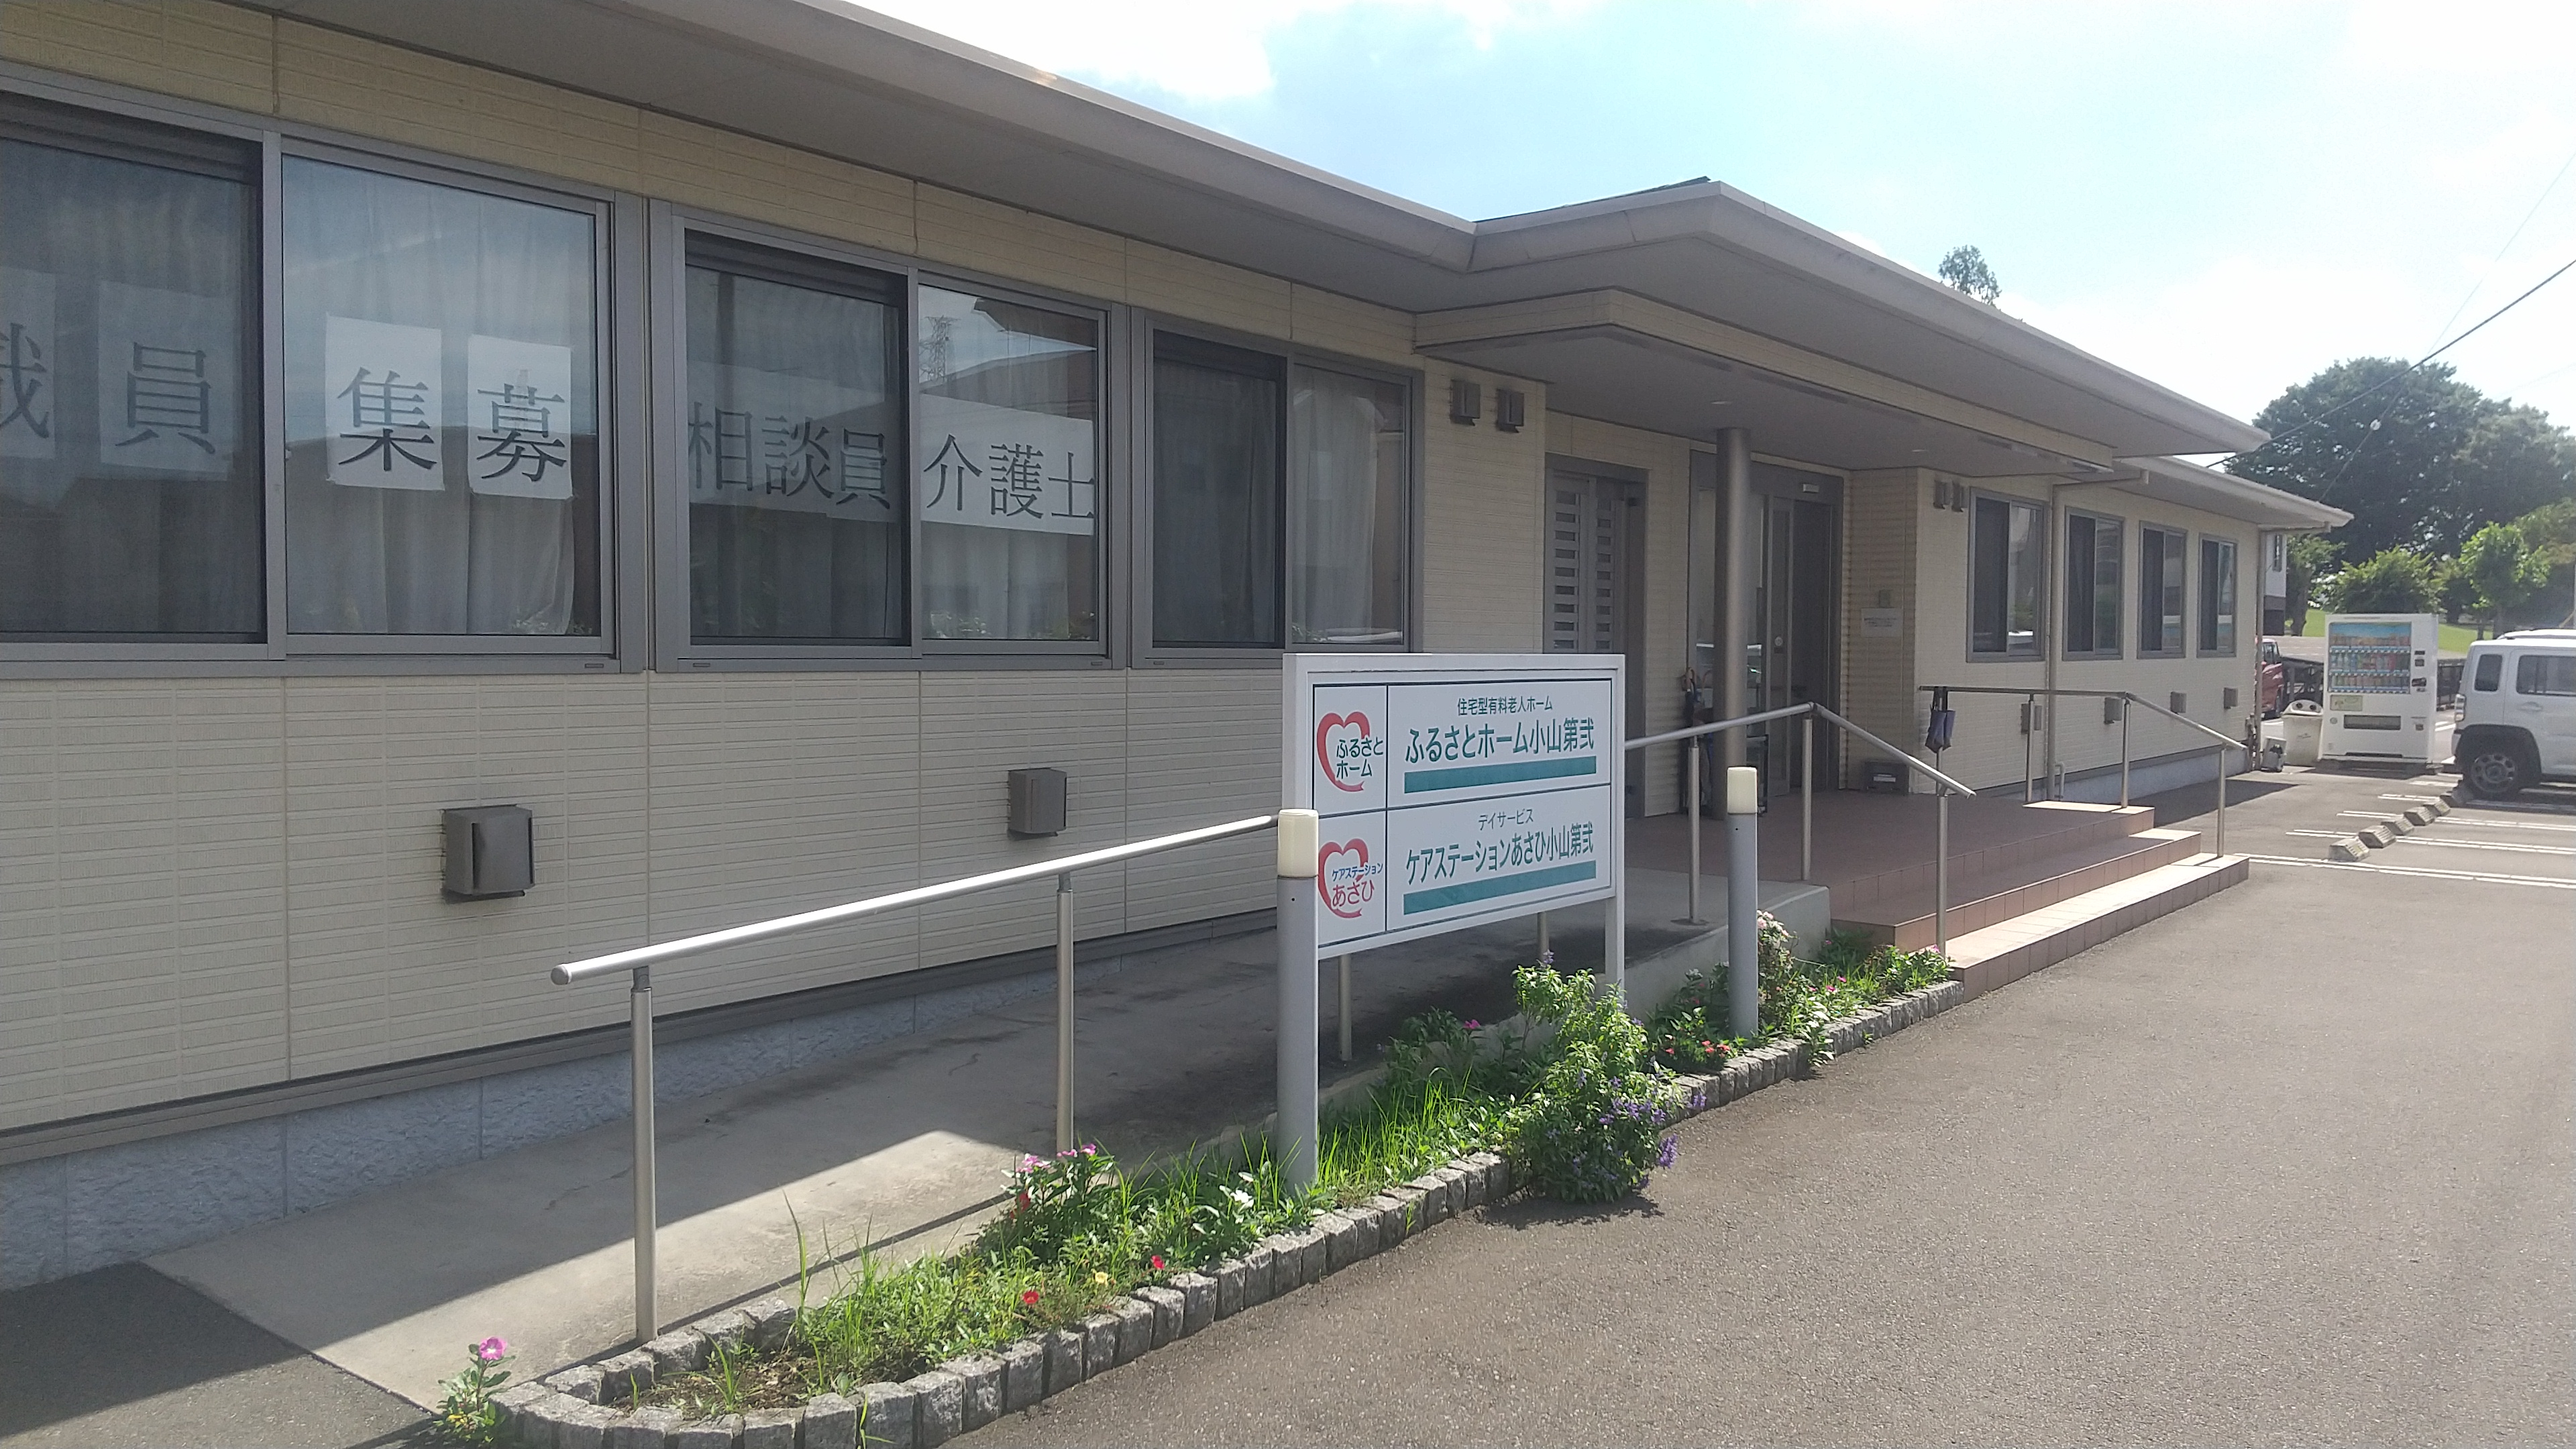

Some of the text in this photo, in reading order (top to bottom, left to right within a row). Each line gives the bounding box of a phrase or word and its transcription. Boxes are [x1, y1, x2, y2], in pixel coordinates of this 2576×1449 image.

[337, 366, 567, 482] 集募
[688, 402, 1094, 519] 相談員 介護士
[1457, 696, 1553, 716] 住宅型有料老人ホーム
[1336, 737, 1383, 758] ふるさと
[1405, 716, 1595, 763] ふるさとホーム小山第弐
[1336, 759, 1373, 780] ホーム
[1479, 808, 1534, 830] デイサービス
[1406, 820, 1594, 885] ケアステーションあさひ小山第弐
[1332, 863, 1383, 881] ケアステーション
[1332, 879, 1375, 907] あさひ
